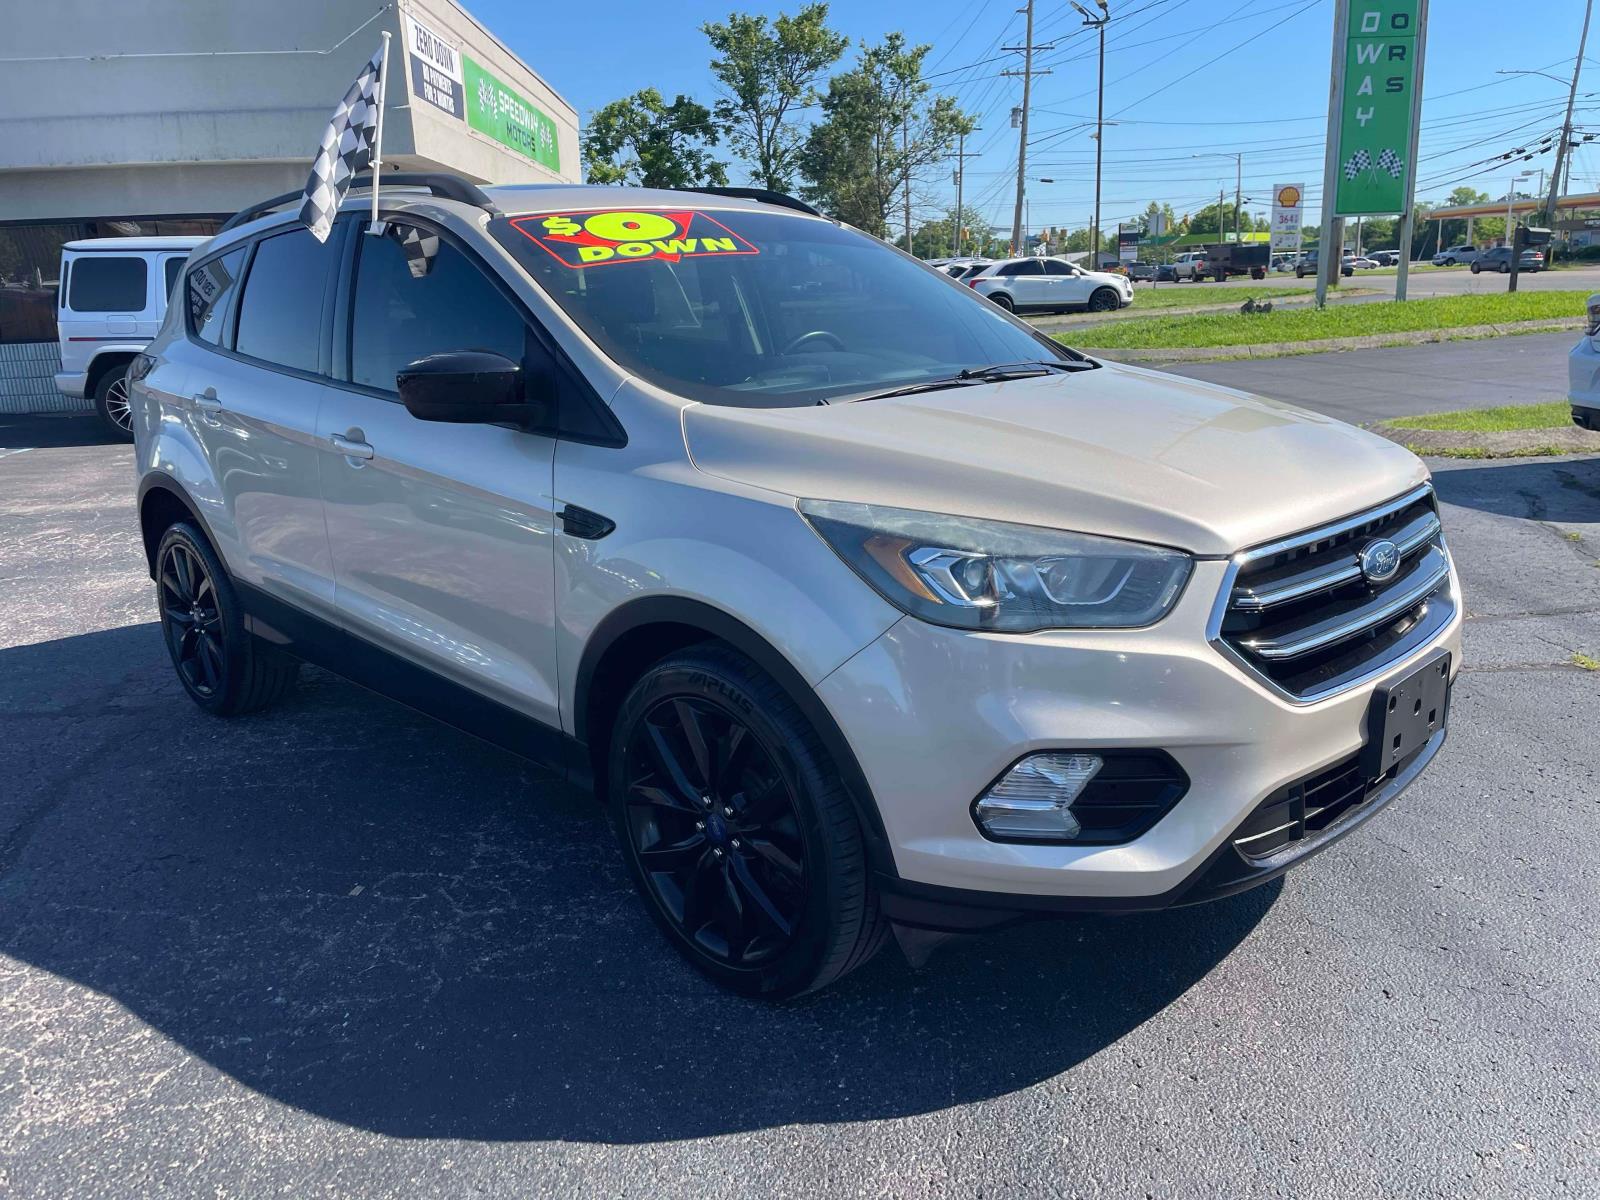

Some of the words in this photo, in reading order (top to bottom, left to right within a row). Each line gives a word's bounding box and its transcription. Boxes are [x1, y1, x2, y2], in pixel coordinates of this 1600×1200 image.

[414, 24, 433, 60] ZERO
[434, 38, 454, 73] DOWN
[498, 89, 538, 134] SPEEDWAY
[506, 121, 536, 152] MOTORS
[578, 237, 737, 262] DOWN
